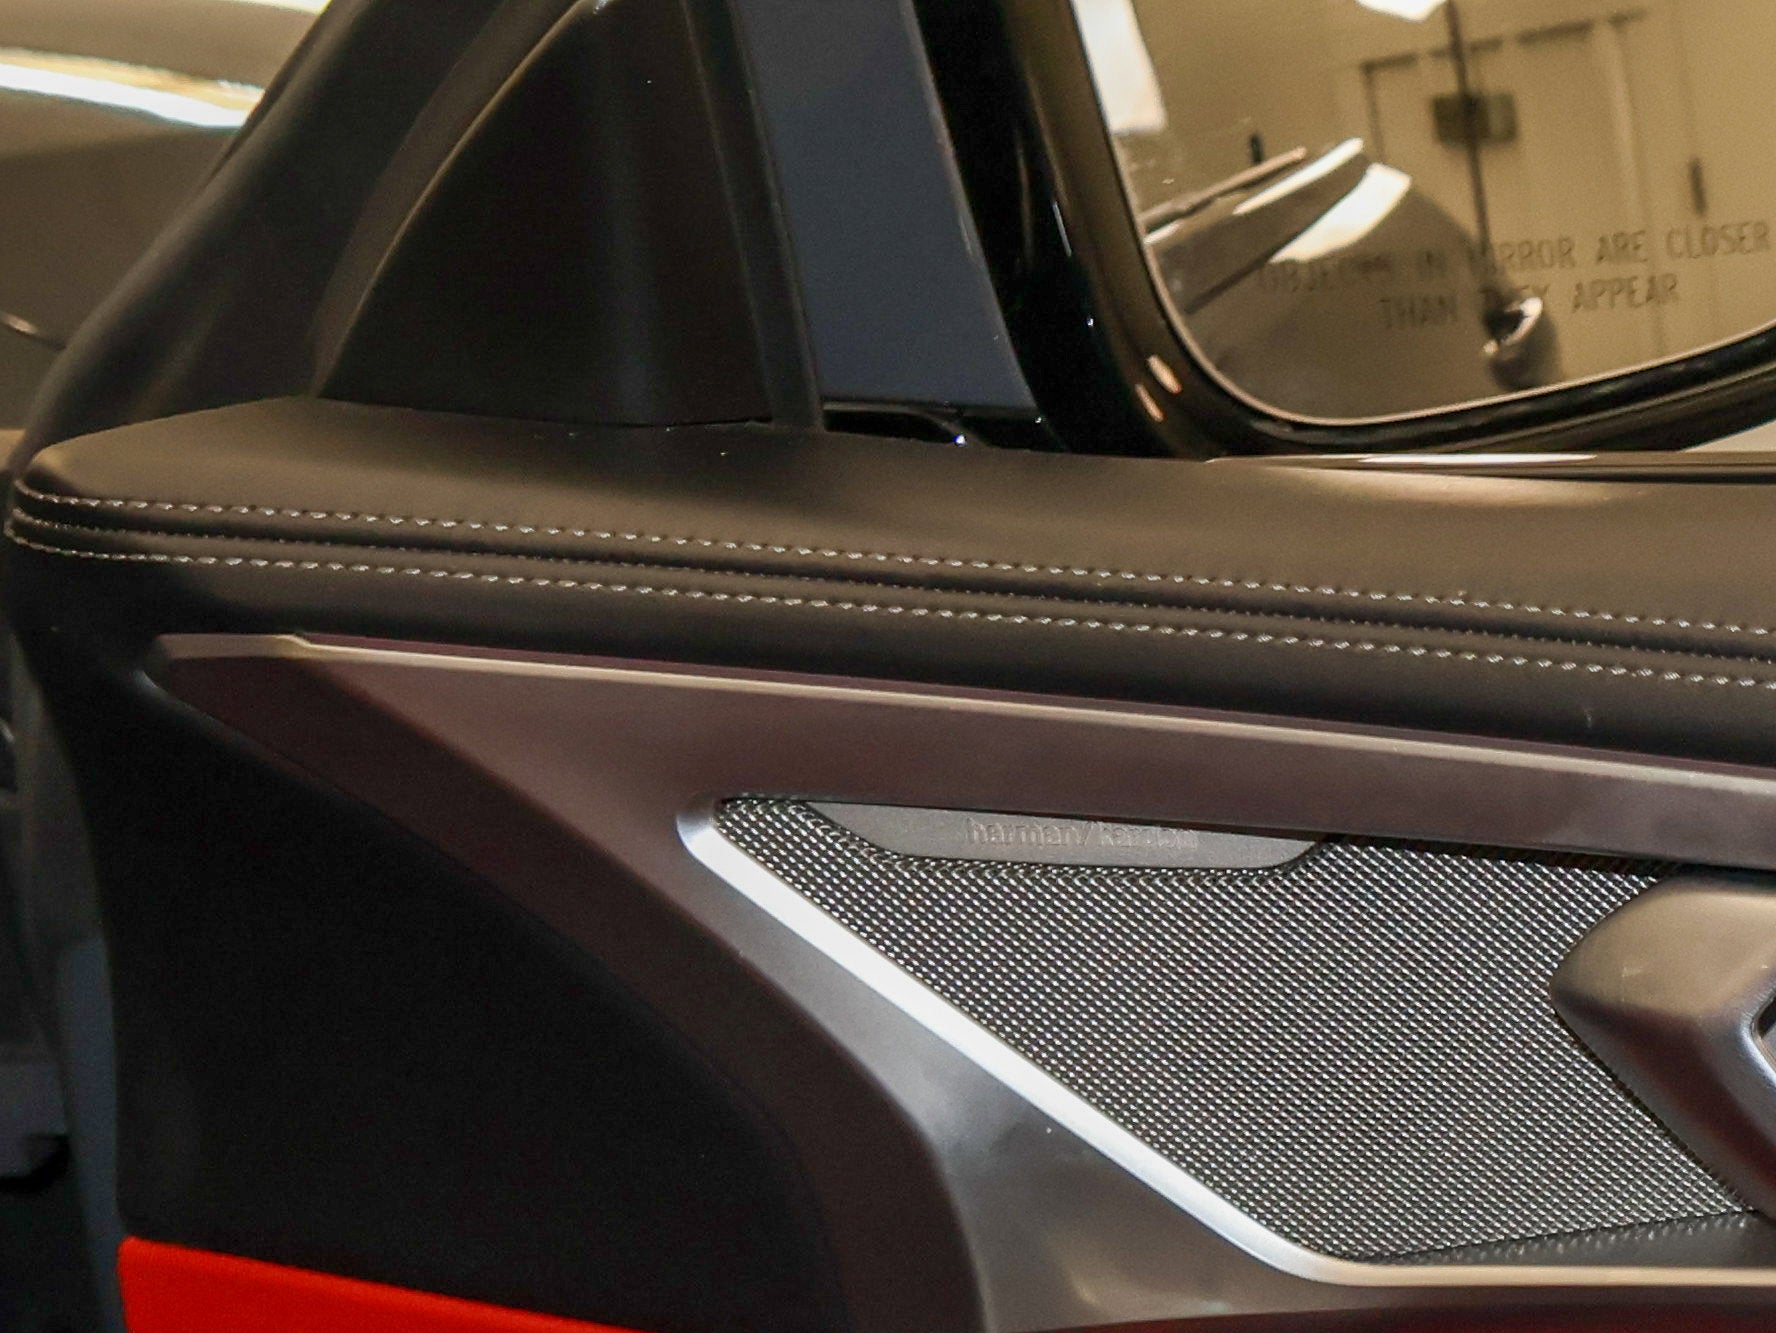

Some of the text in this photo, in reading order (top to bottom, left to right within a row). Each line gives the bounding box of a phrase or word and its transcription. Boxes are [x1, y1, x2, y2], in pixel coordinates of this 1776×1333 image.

[1596, 230, 1648, 264] ARE
[1666, 220, 1769, 260] CLOSER
[1571, 272, 1681, 314] APPEAR
